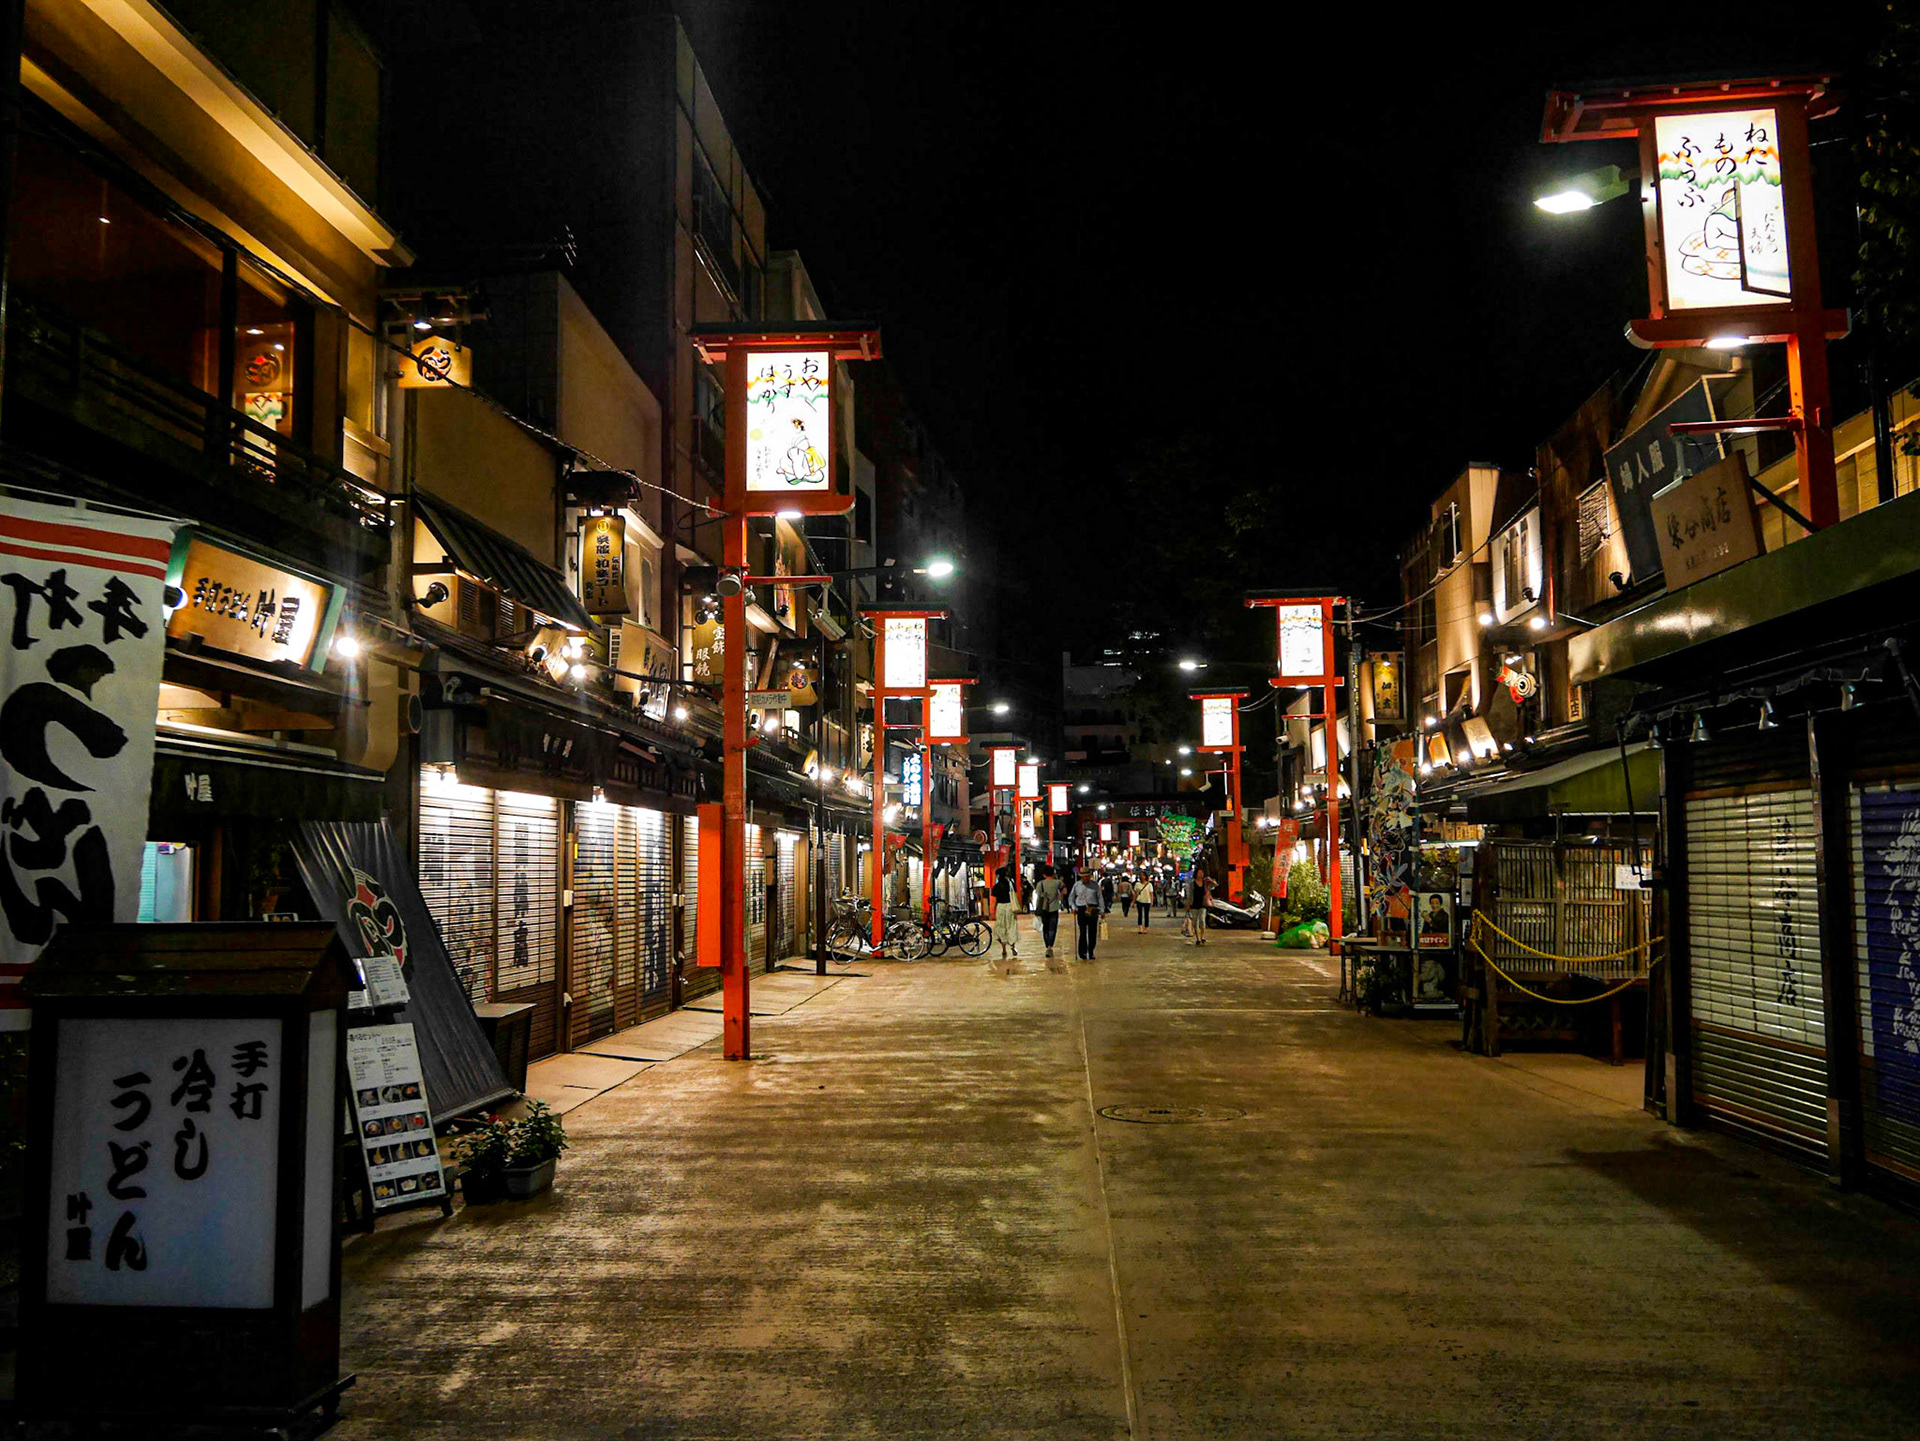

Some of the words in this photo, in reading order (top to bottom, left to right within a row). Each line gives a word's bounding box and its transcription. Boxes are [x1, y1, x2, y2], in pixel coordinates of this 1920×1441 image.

[1673, 136, 1705, 208] ふうふ
[1714, 132, 1737, 176] もの
[1744, 122, 1769, 165] ねた
[170, 1048, 216, 1182] 冷し
[230, 1039, 269, 1121] 手打
[104, 1072, 153, 1272] うどん
